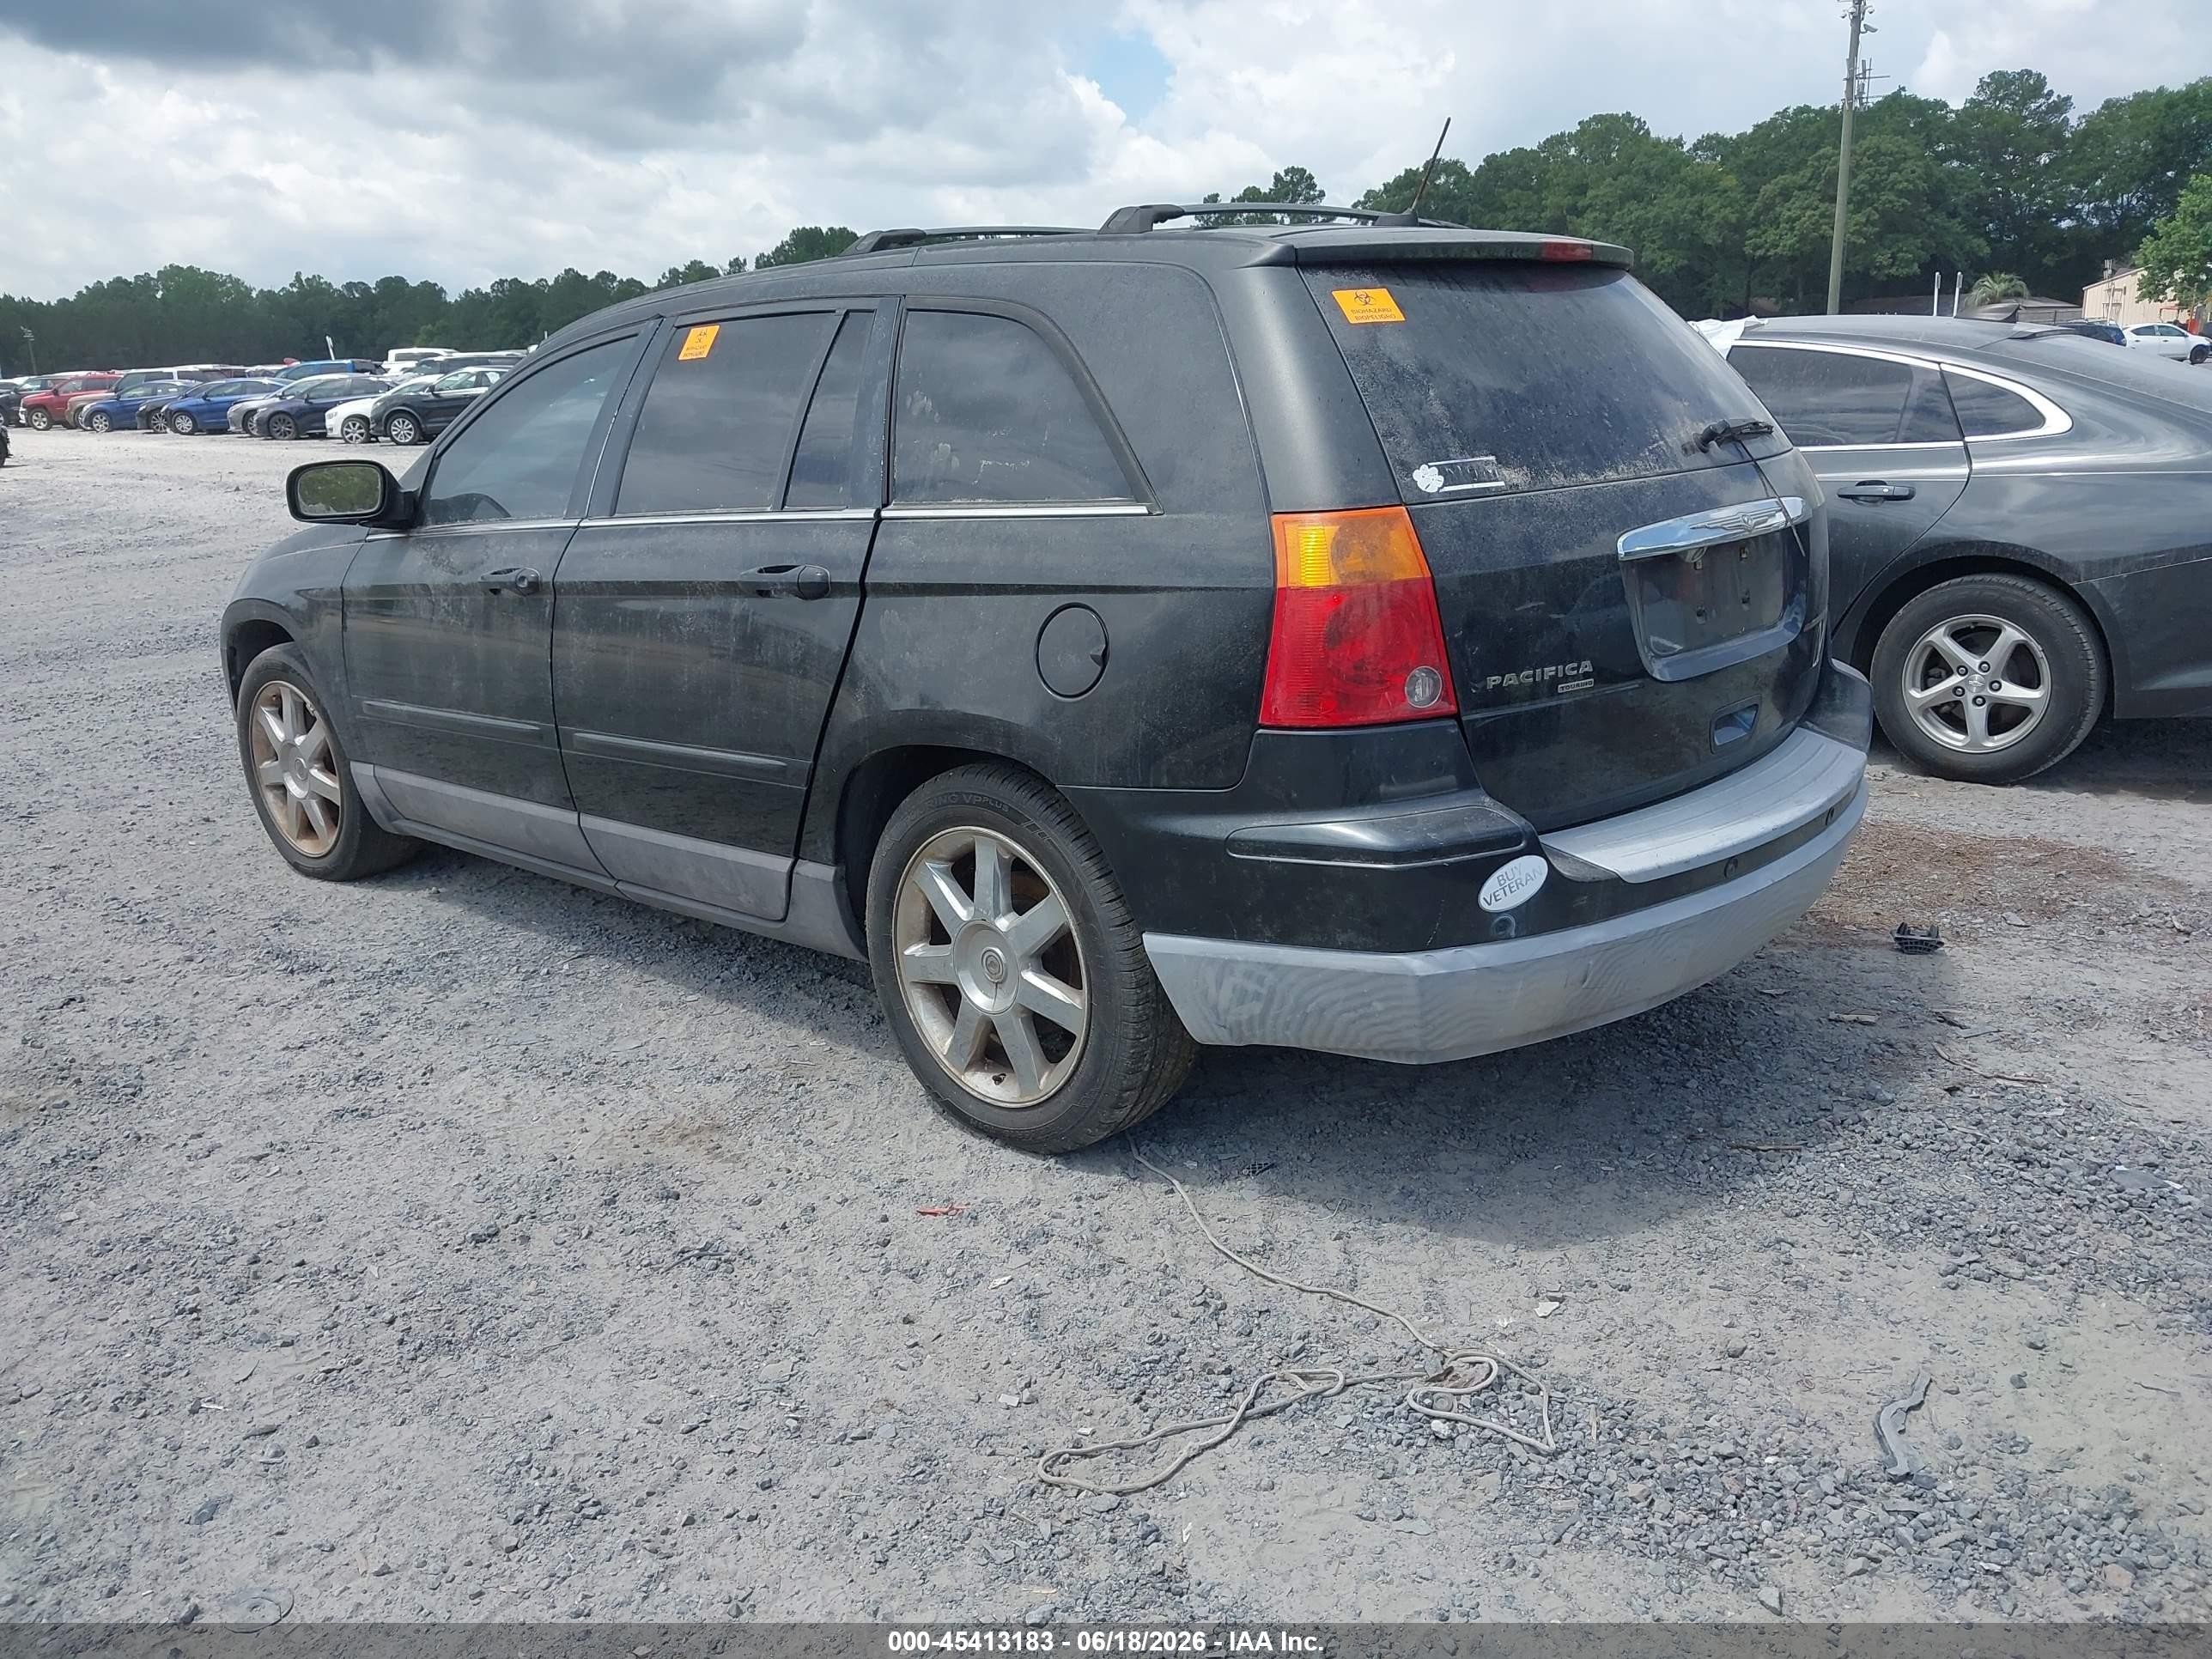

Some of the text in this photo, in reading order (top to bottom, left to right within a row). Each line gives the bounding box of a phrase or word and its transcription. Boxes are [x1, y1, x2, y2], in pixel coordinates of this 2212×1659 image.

[1486, 660, 1594, 690] PACIFICA
[1483, 866, 1543, 906] VETERAN
[1497, 862, 1522, 887] BUY
